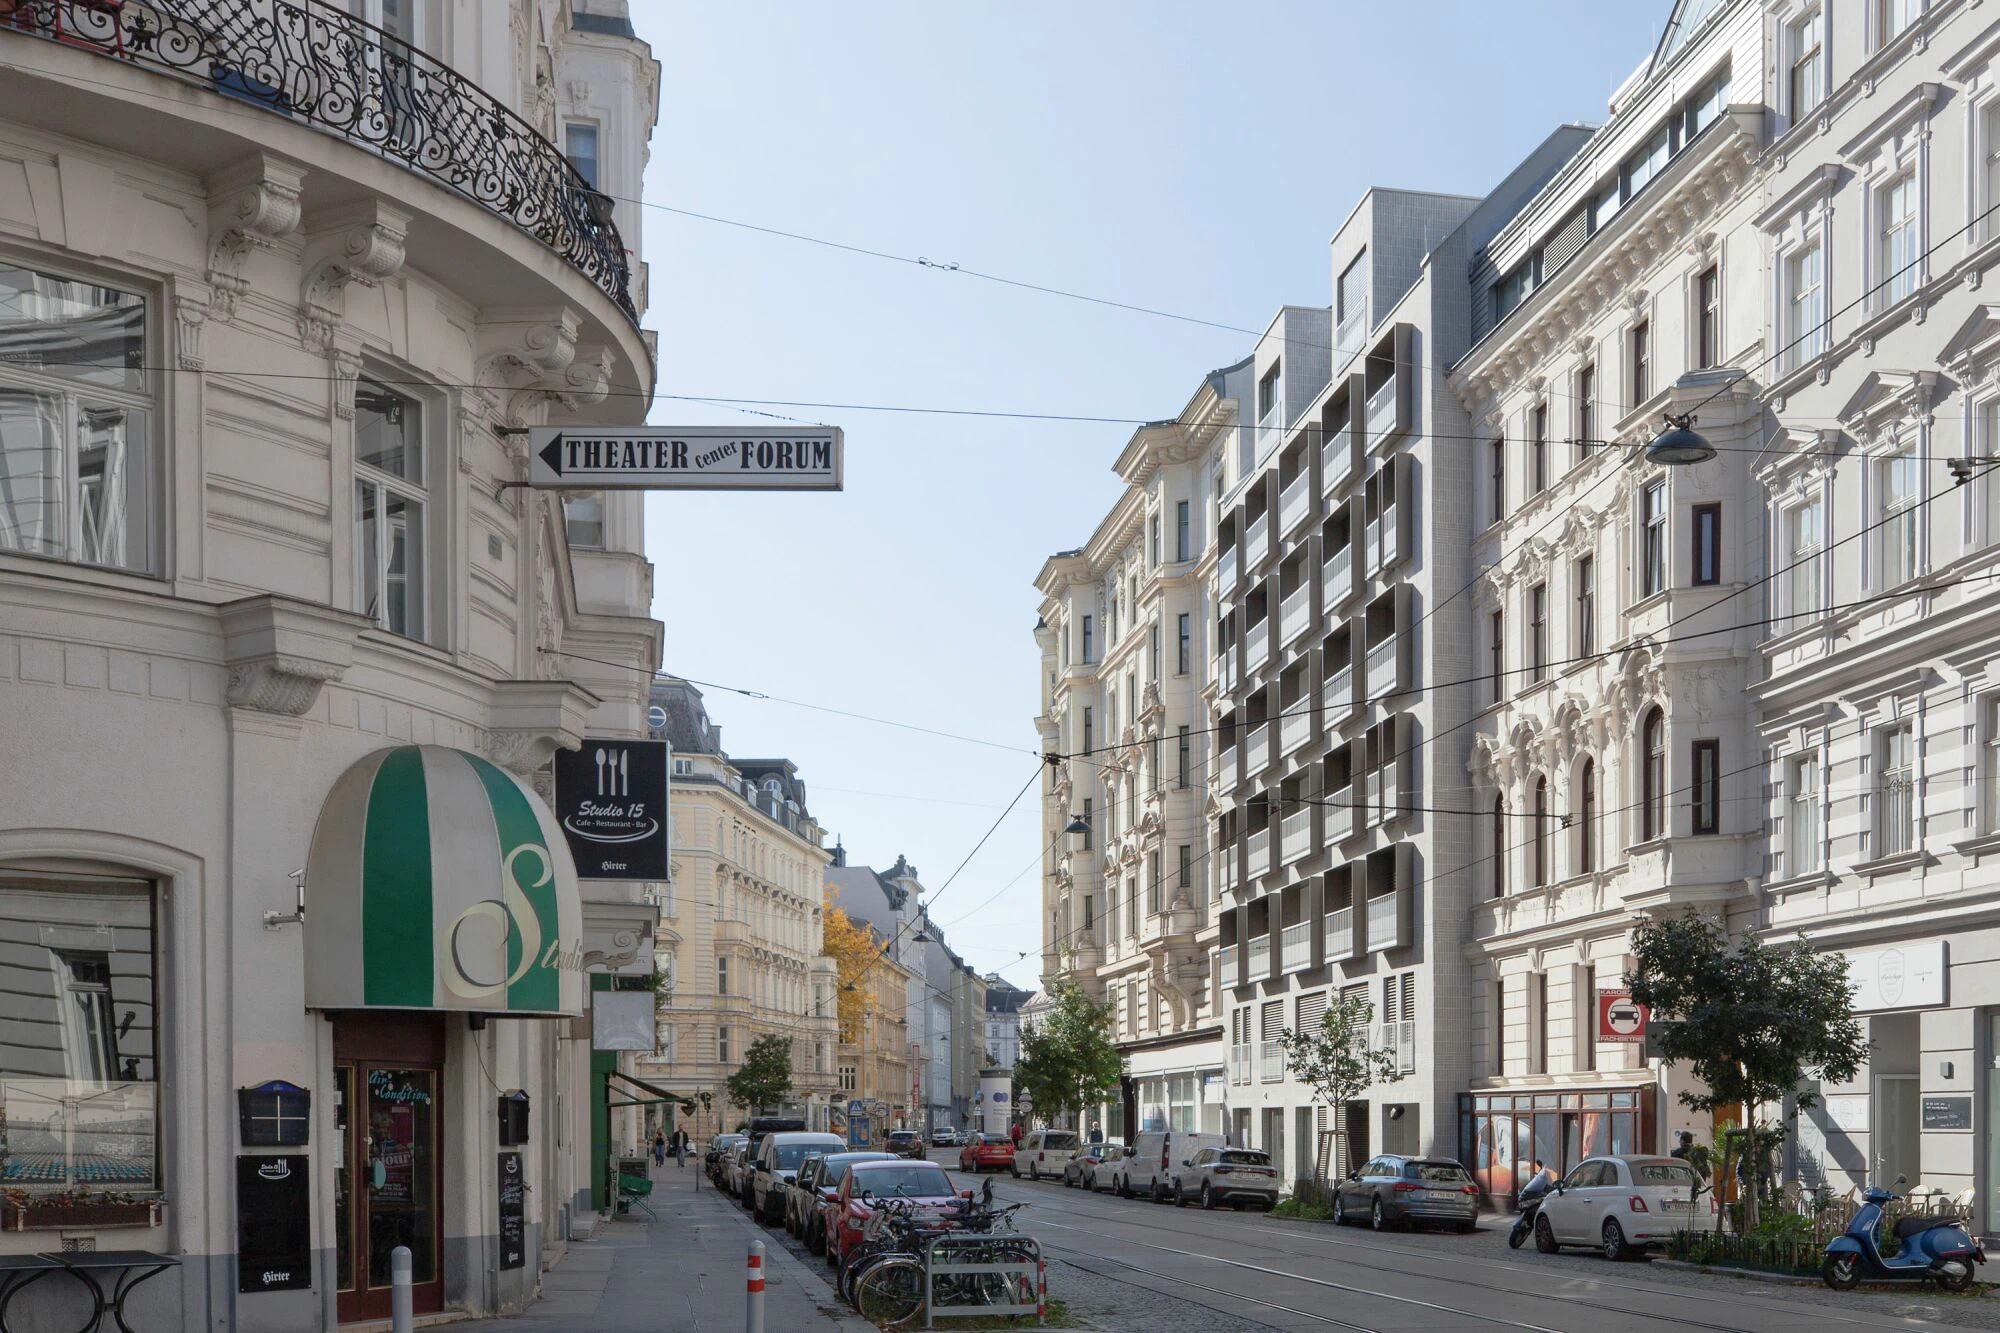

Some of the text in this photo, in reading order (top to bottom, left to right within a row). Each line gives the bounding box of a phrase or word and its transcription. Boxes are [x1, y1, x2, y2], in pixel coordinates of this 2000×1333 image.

[566, 441, 831, 469] THEATER center FORUM
[578, 801, 645, 818] Studio 15
[576, 819, 591, 827] Cafe
[596, 820, 631, 828] Restaurant
[601, 861, 627, 871] Hirter
[440, 843, 583, 999] Studi
[380, 1084, 428, 1101] Condition
[262, 1271, 290, 1285] Hirter
